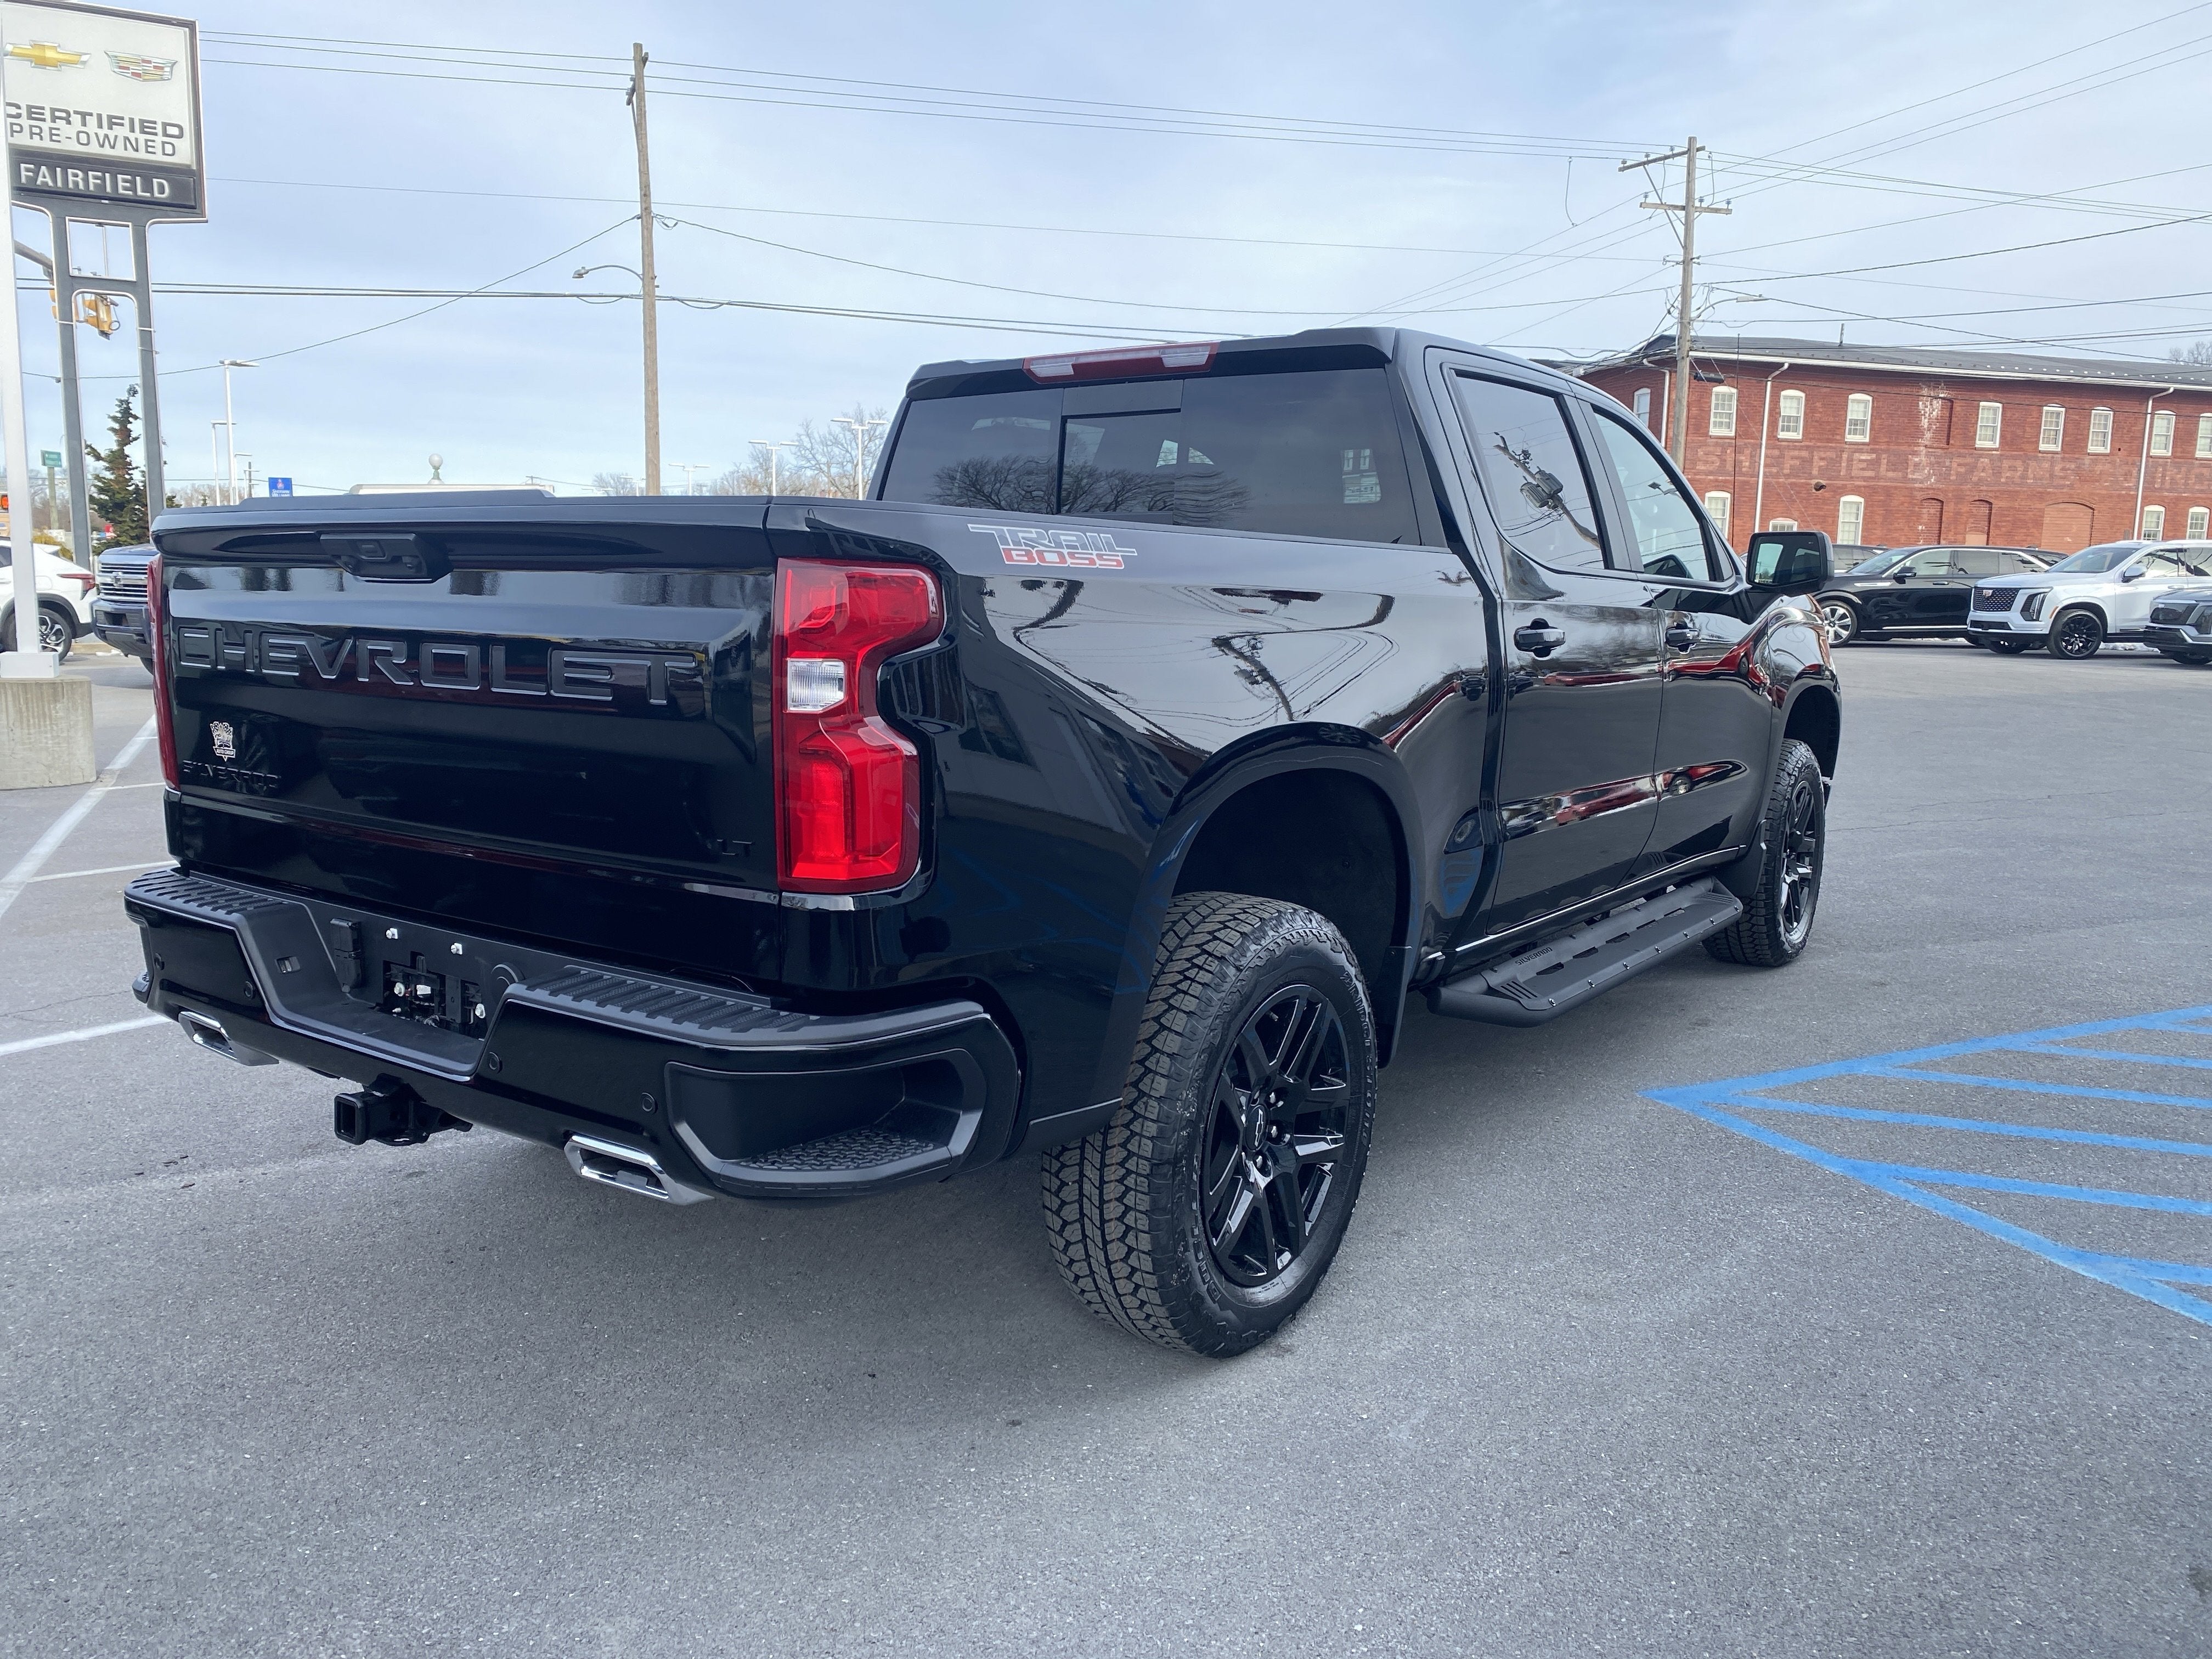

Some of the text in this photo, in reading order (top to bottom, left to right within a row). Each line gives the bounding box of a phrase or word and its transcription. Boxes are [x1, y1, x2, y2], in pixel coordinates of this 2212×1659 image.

[5, 101, 184, 139] CERTIFIED
[9, 122, 176, 156] PRE-OWNED
[20, 163, 170, 199] FAIRFIELD
[967, 524, 1137, 556] TRAIL
[1001, 548, 1124, 569] BOSS
[177, 626, 697, 706] CHEVROLET
[1515, 947, 1553, 966] SILVERADO
